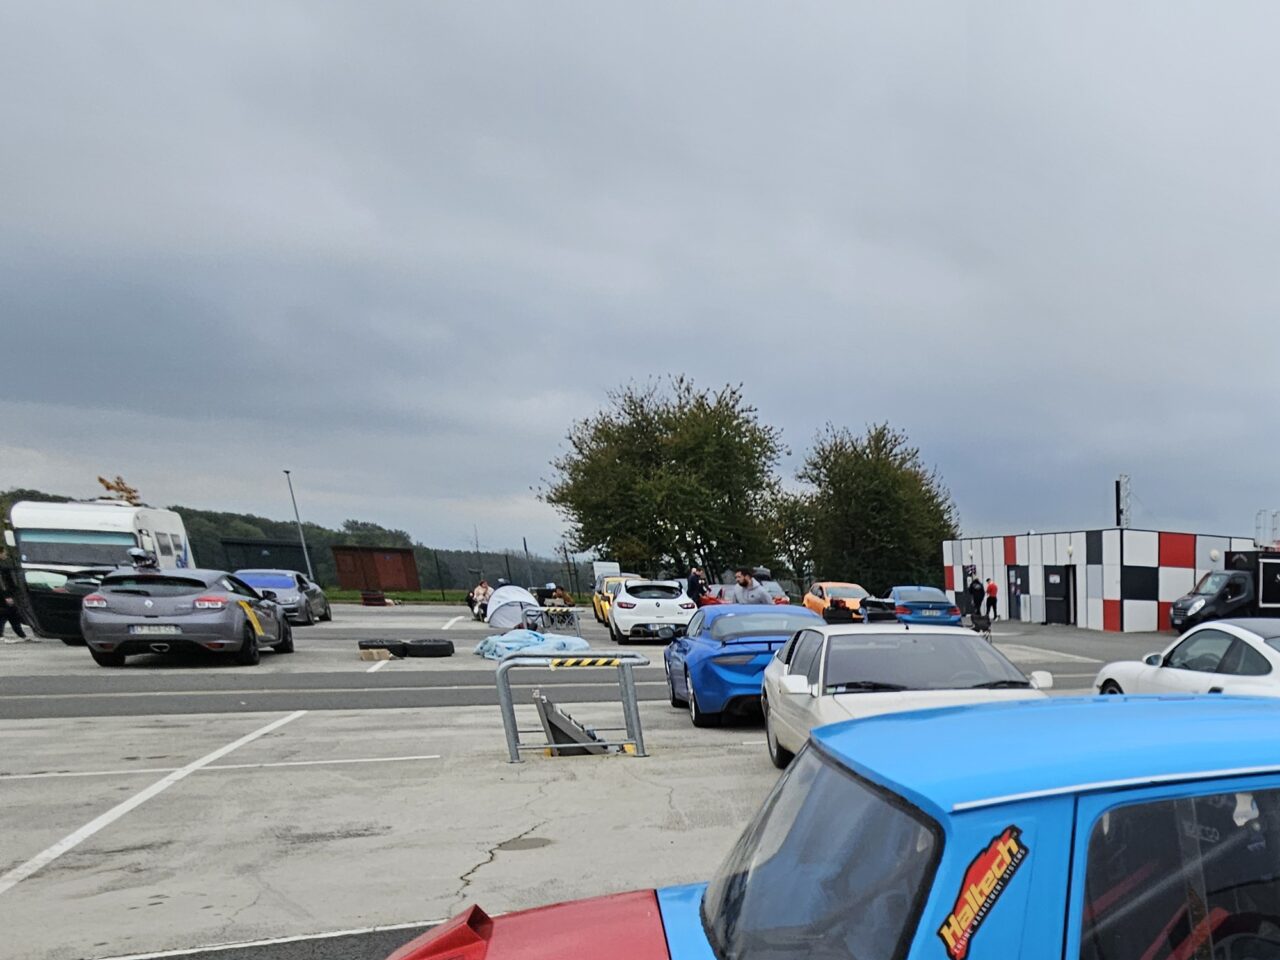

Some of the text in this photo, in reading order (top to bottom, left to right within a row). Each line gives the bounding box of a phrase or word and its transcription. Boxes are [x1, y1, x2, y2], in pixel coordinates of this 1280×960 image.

[940, 838, 1019, 949] Haltech
[972, 881, 1005, 926] MANAGEMENT
[1003, 848, 1026, 880] SYSTEMS
